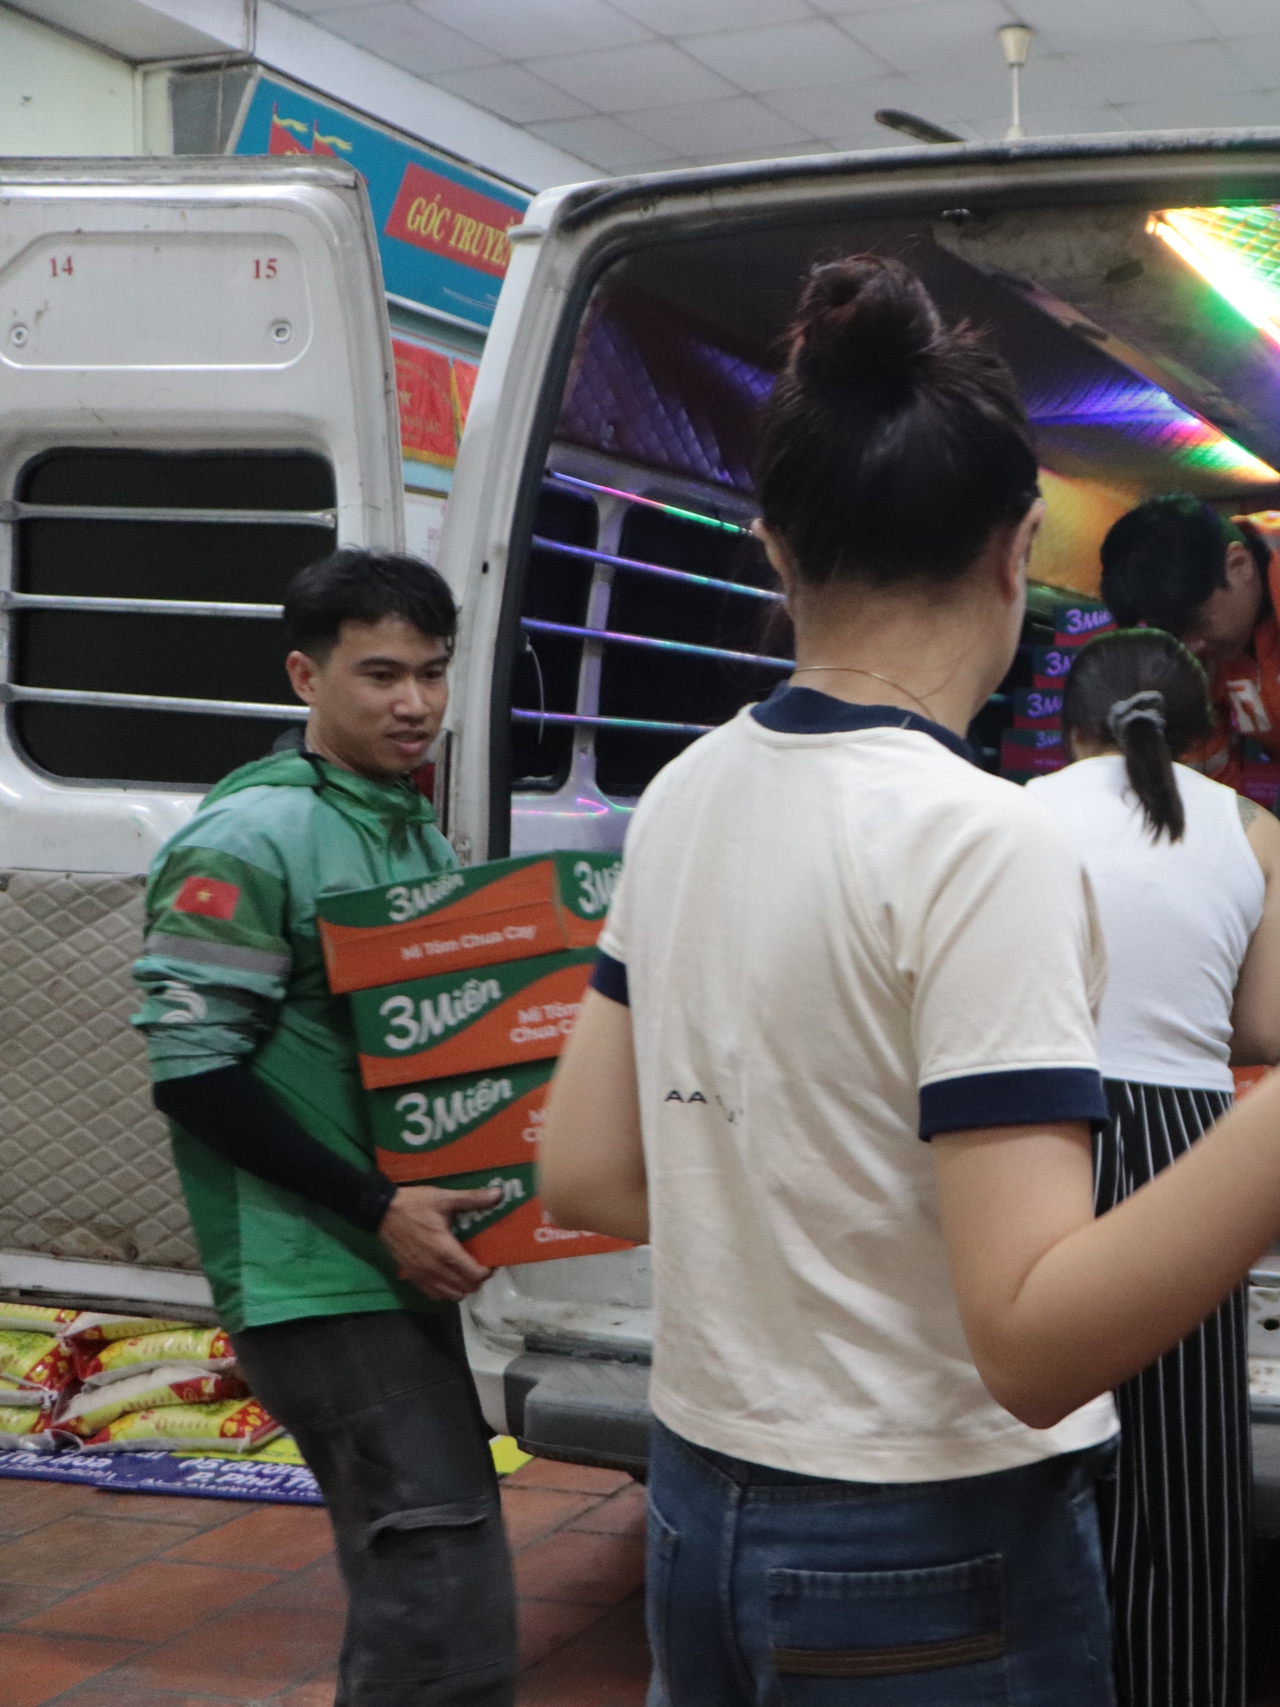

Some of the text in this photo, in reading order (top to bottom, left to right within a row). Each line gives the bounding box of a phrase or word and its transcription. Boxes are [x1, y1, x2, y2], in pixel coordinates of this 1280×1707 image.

[406, 193, 451, 242] GÓC
[50, 255, 75, 278] 14
[252, 257, 278, 279] 15
